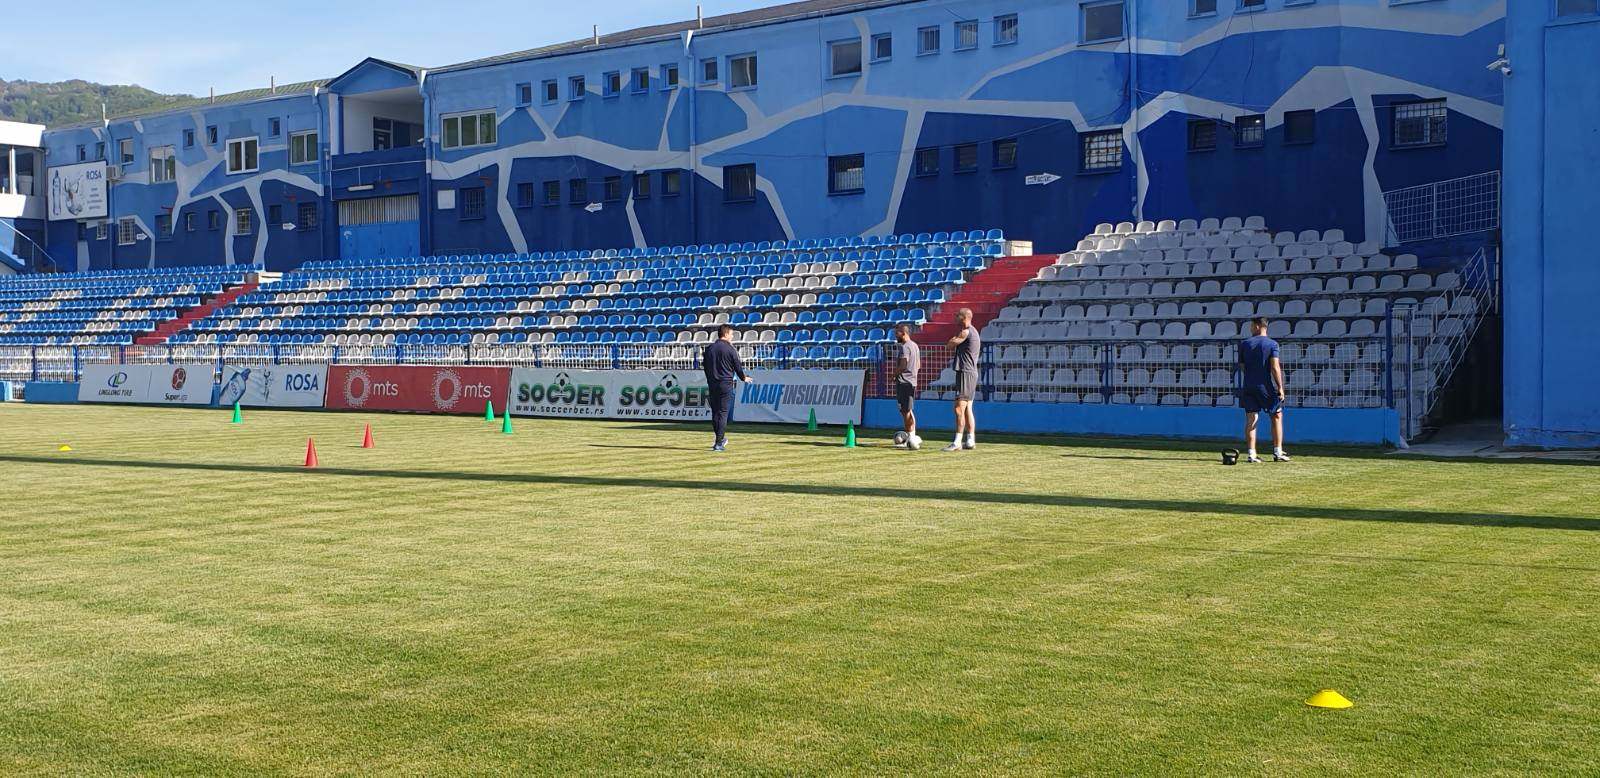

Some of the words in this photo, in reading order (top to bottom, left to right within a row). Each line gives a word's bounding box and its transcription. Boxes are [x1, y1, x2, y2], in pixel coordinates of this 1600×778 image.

[285, 374, 319, 391] ROSA
[373, 381, 399, 396] mts
[464, 382, 492, 398] mts
[517, 383, 606, 406] SOCCER
[516, 404, 605, 415] www.soccerbet.rs
[617, 407, 711, 417] www.soccerbet.r
